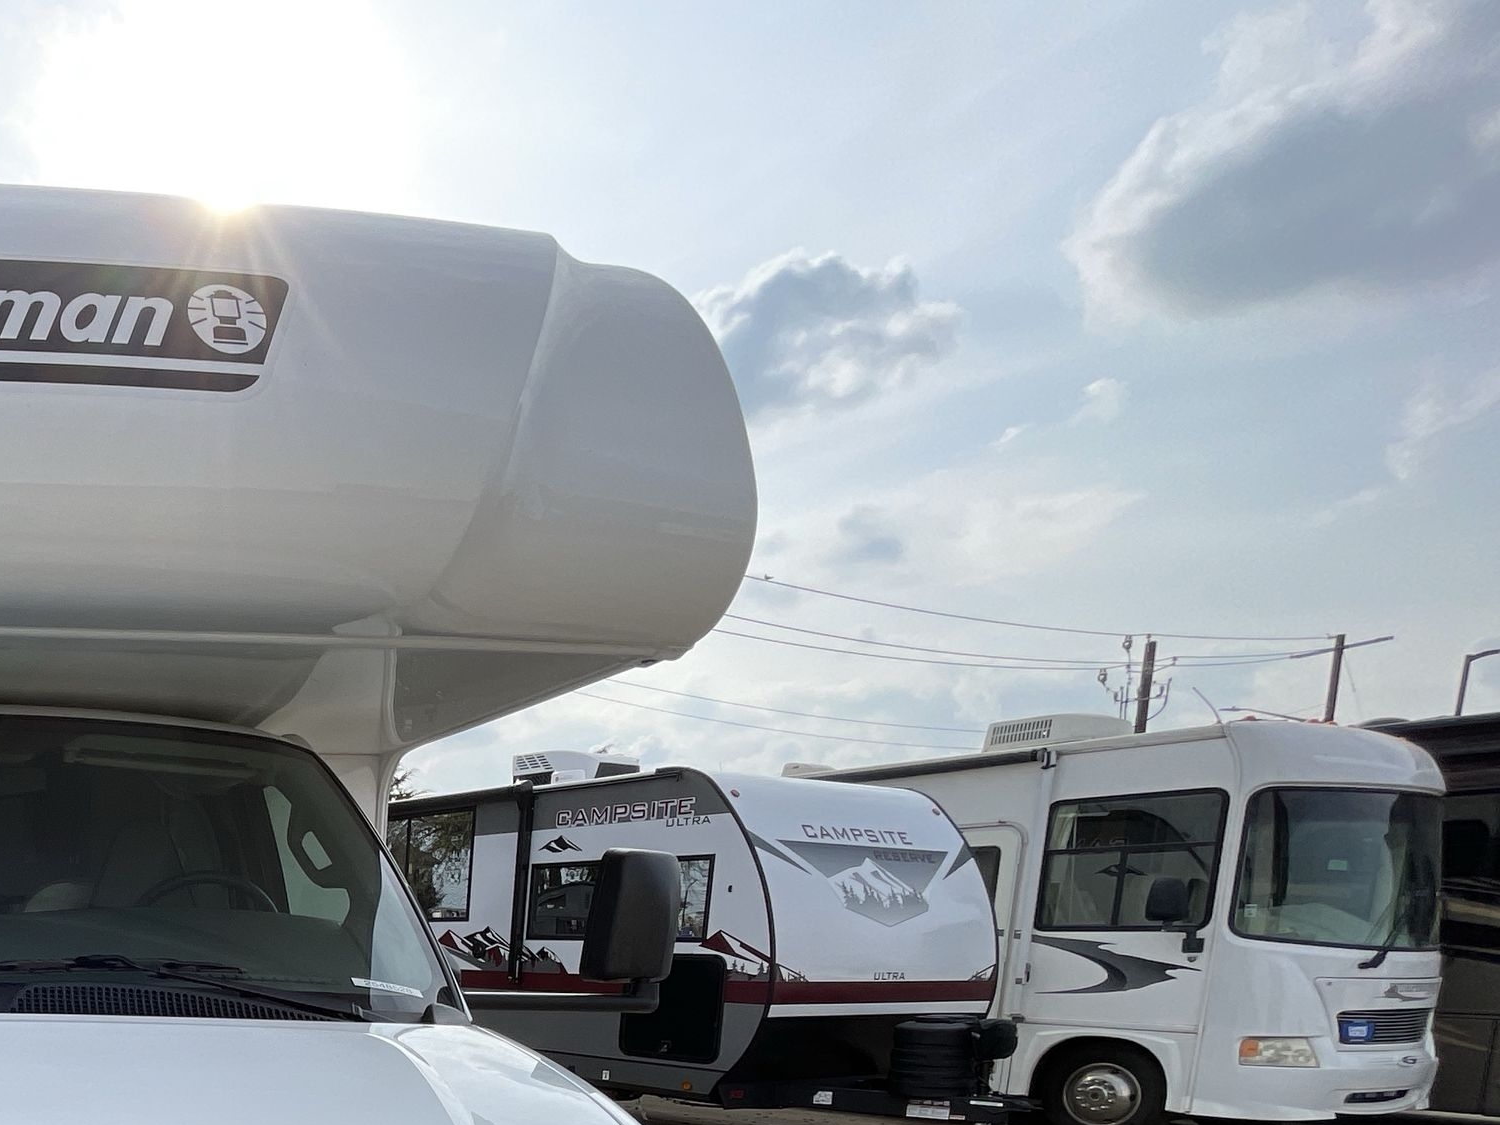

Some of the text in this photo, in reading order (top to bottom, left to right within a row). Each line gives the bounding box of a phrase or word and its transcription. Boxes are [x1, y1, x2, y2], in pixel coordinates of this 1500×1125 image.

[556, 796, 696, 828] CAMPSITE
[665, 815, 711, 828] ULTRA
[801, 824, 913, 846] CAMPSITE
[873, 850, 937, 864] RESERVE
[873, 971, 906, 981] ULTRA
